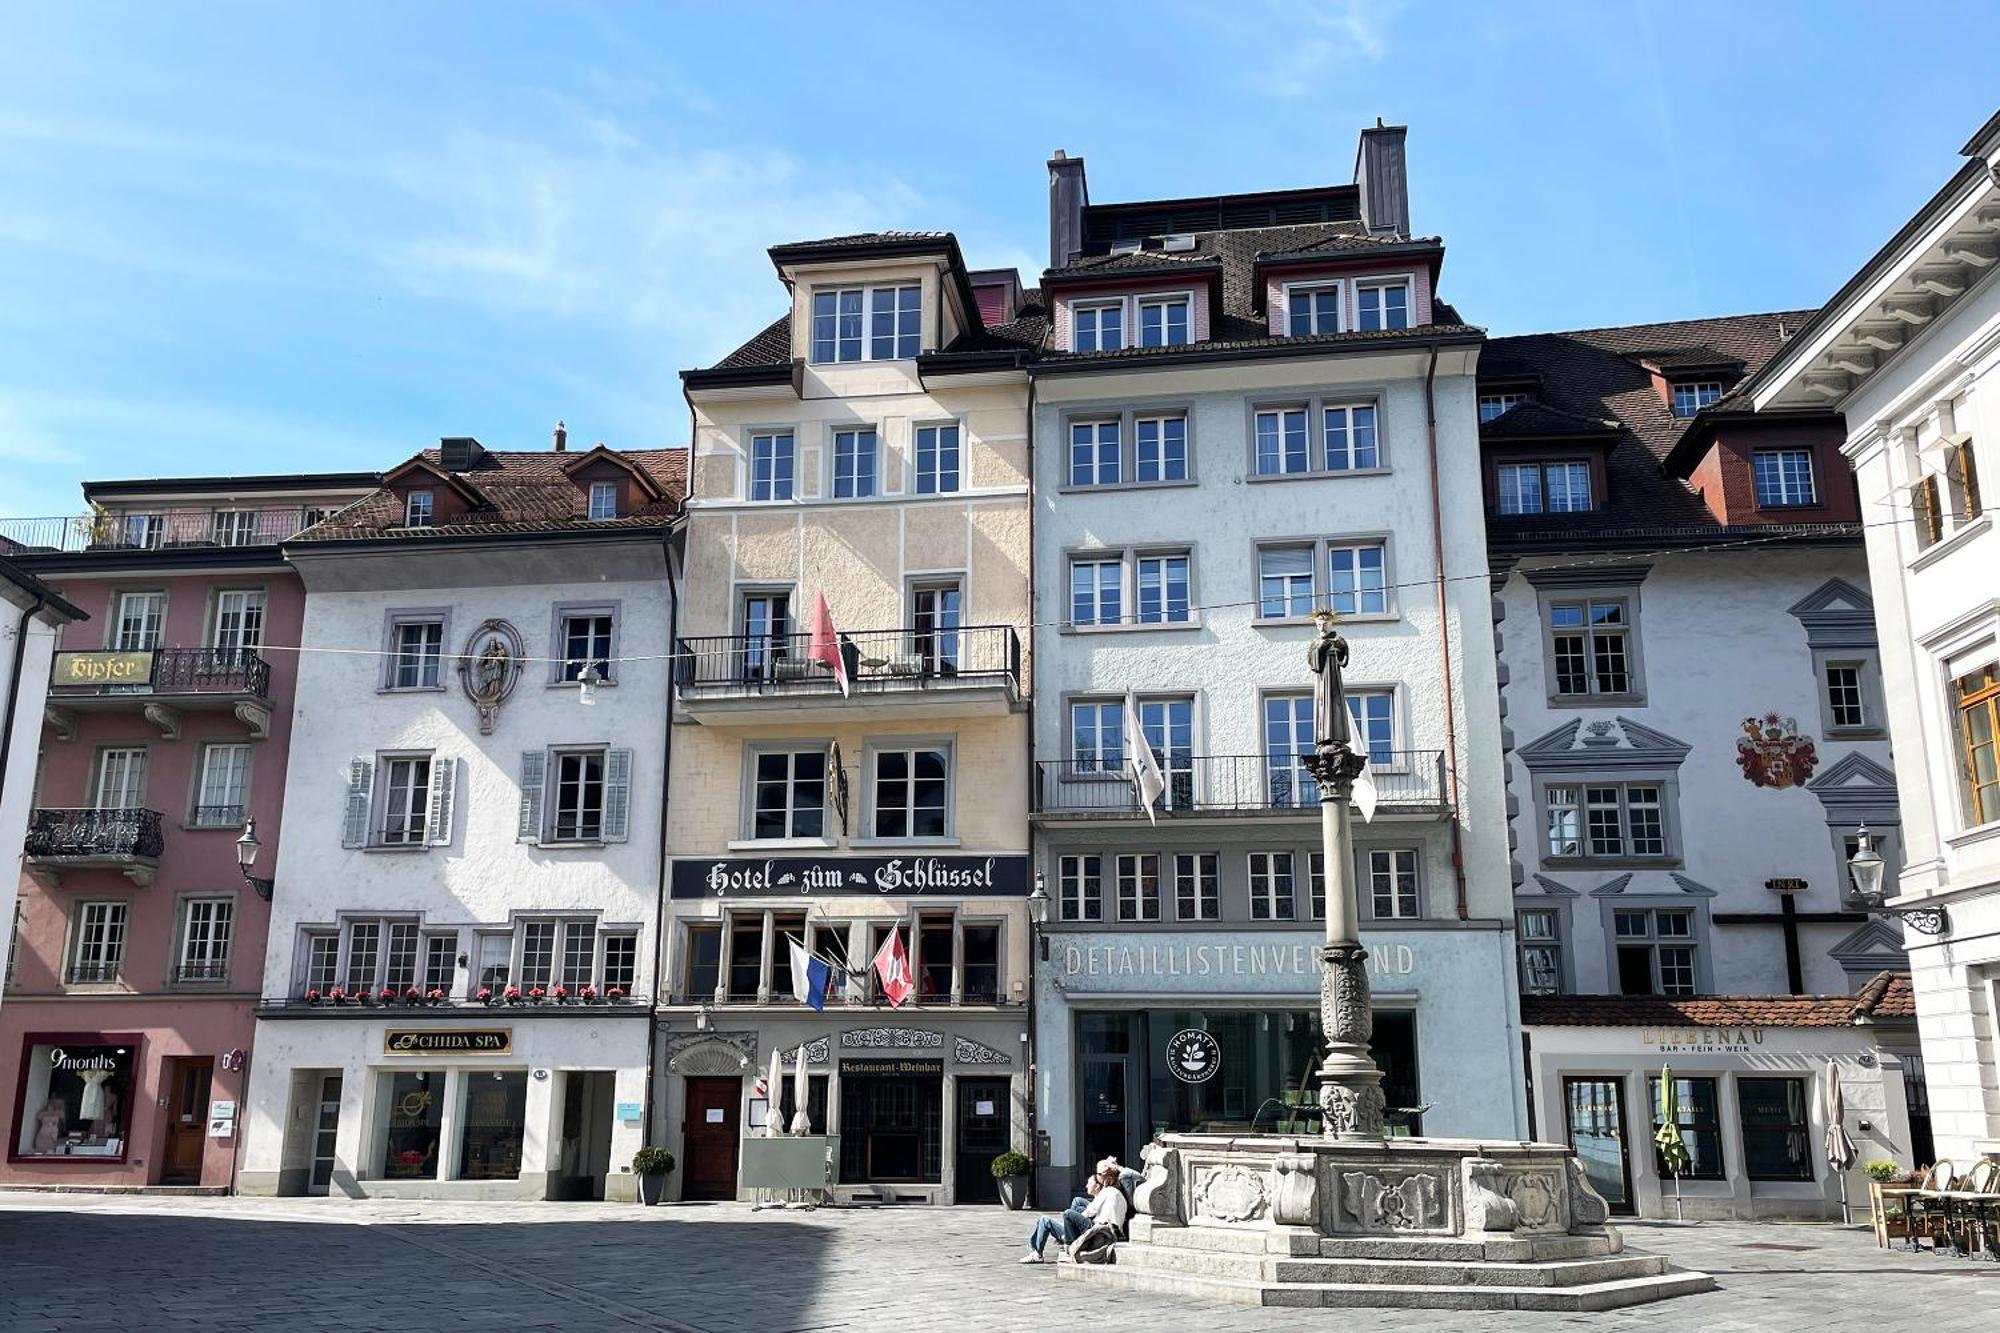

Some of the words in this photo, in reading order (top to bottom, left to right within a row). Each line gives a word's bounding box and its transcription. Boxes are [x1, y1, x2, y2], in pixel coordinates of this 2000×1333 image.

[706, 859, 775, 896] Hotel
[801, 865, 844, 894] zum
[874, 857, 996, 894] Schlüssel
[1065, 945, 1415, 976] DETAILLISTENVERND
[475, 1034, 500, 1048] SPA
[1172, 1032, 1215, 1049] HOMATT
[1642, 1028, 1765, 1045] LIEBENAU
[1660, 1045, 1678, 1053] BAR
[1691, 1045, 1713, 1053] FEIN
[1725, 1045, 1750, 1053] WEIN
